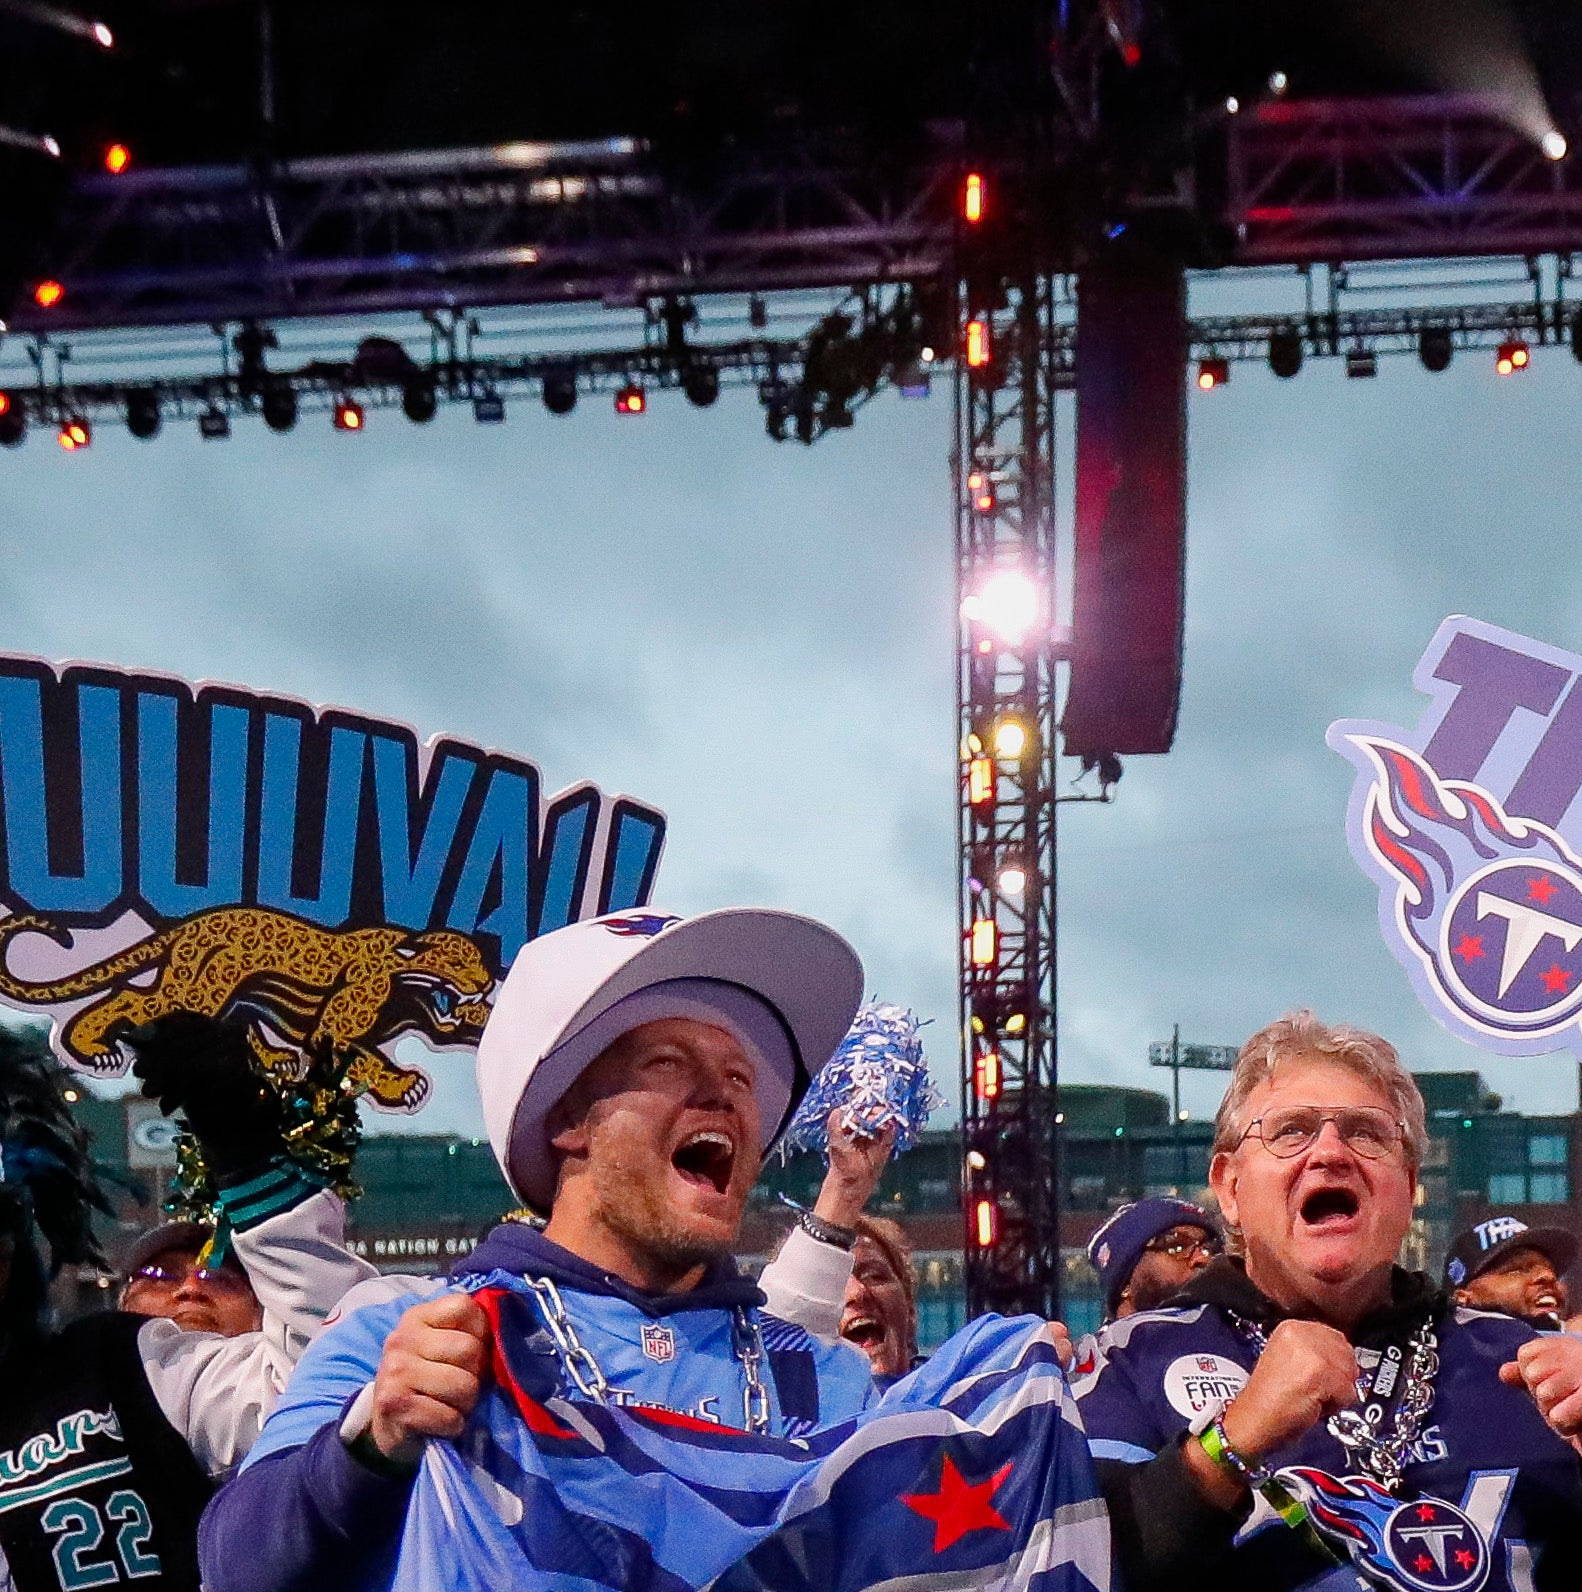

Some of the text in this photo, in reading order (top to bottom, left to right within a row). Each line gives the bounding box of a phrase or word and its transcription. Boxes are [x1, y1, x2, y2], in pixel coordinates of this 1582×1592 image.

[374, 1238, 440, 1256] NATION
[1185, 1381, 1232, 1400] FAN
[40, 1489, 162, 1592] 22
